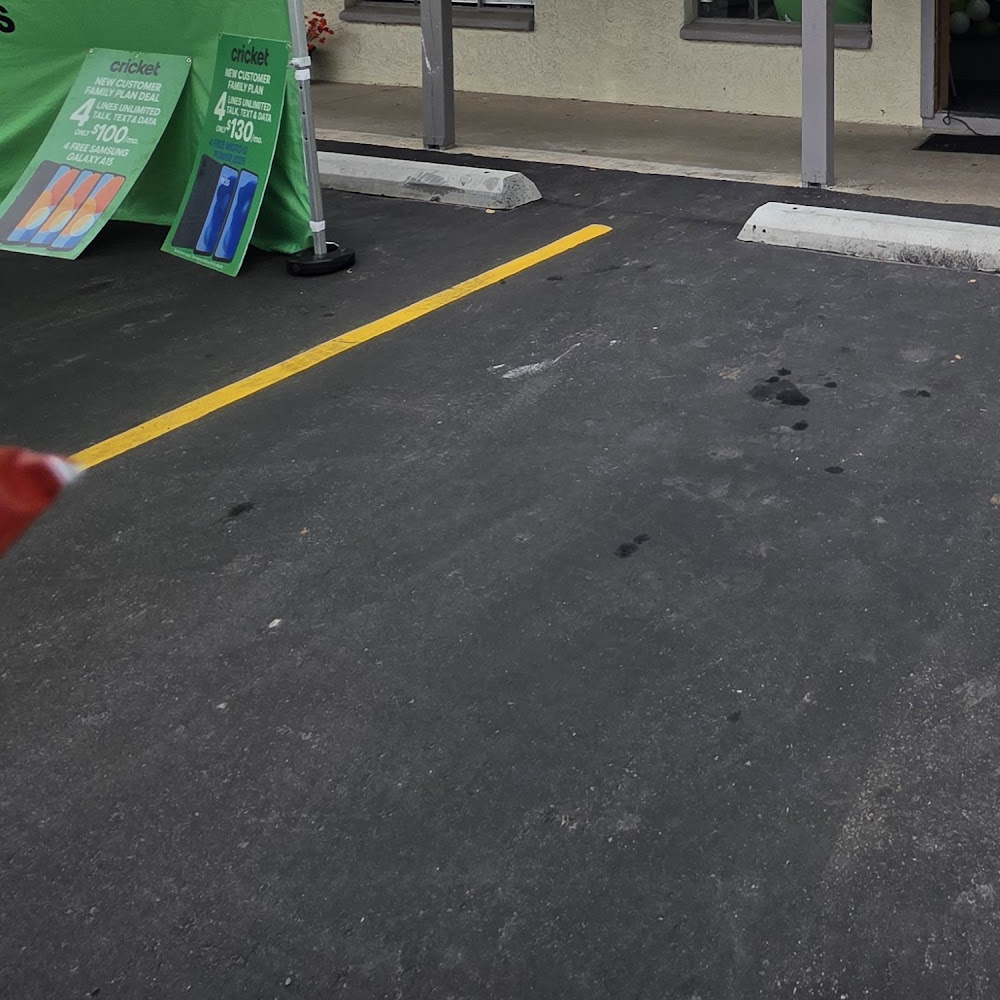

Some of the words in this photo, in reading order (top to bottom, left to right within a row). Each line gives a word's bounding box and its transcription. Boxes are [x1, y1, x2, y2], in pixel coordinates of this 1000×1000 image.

[231, 45, 269, 66] cricket
[110, 59, 161, 76] cricket
[224, 68, 238, 78] NEW
[238, 70, 271, 84] CUSTOMER
[95, 77, 116, 87] NEW
[116, 79, 162, 91] CUSTOMER
[227, 81, 248, 91] FAMILY
[247, 83, 264, 95] PLAN
[84, 86, 115, 97] FAMILY
[115, 89, 139, 100] PLAN
[138, 91, 160, 102] DEAL
[96, 101, 118, 112] LINES
[118, 104, 161, 116] UNLIMITED
[214, 92, 227, 121] 4
[227, 95, 241, 106] LINES
[242, 98, 271, 111] UNLIMITED
[70, 98, 96, 127] 4
[113, 113, 131, 123] TEXT
[137, 116, 157, 125] DATA
[240, 108, 253, 118] TEXT
[258, 112, 272, 122] DATA
[64, 142, 70, 150] 4
[69, 142, 89, 153] FREE
[89, 145, 129, 157] SAMSUNG
[67, 153, 99, 164] GALAXY
[99, 156, 114, 166] A15
